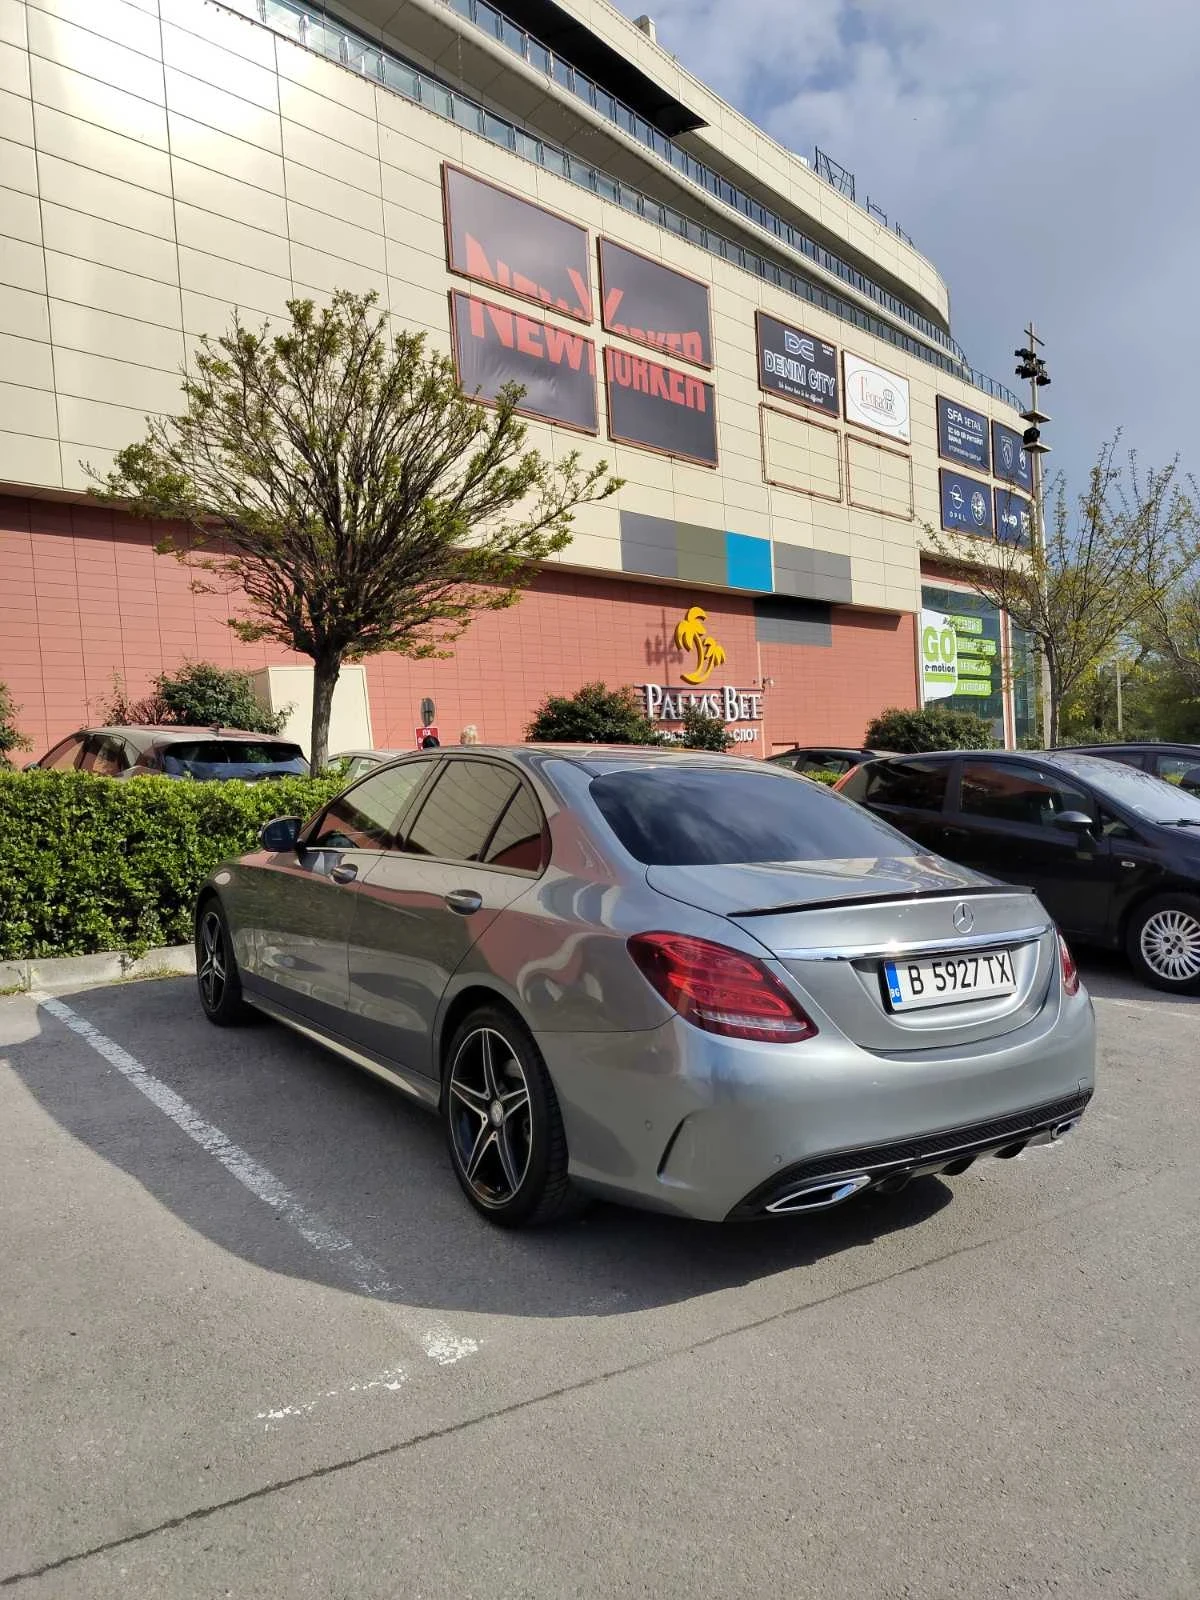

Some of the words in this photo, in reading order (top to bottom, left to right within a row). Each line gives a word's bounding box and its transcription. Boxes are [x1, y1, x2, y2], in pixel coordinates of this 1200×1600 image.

[764, 349, 807, 386] DENIM
[808, 367, 836, 398] CITY
[947, 407, 963, 424] SFA
[949, 511, 967, 522] OPEL
[923, 625, 956, 664] GO
[924, 663, 956, 673] e-motion
[733, 728, 760, 742] СЛОТ
[907, 964, 925, 996] B
[932, 958, 979, 991] 5927
[984, 955, 1010, 984] TX
